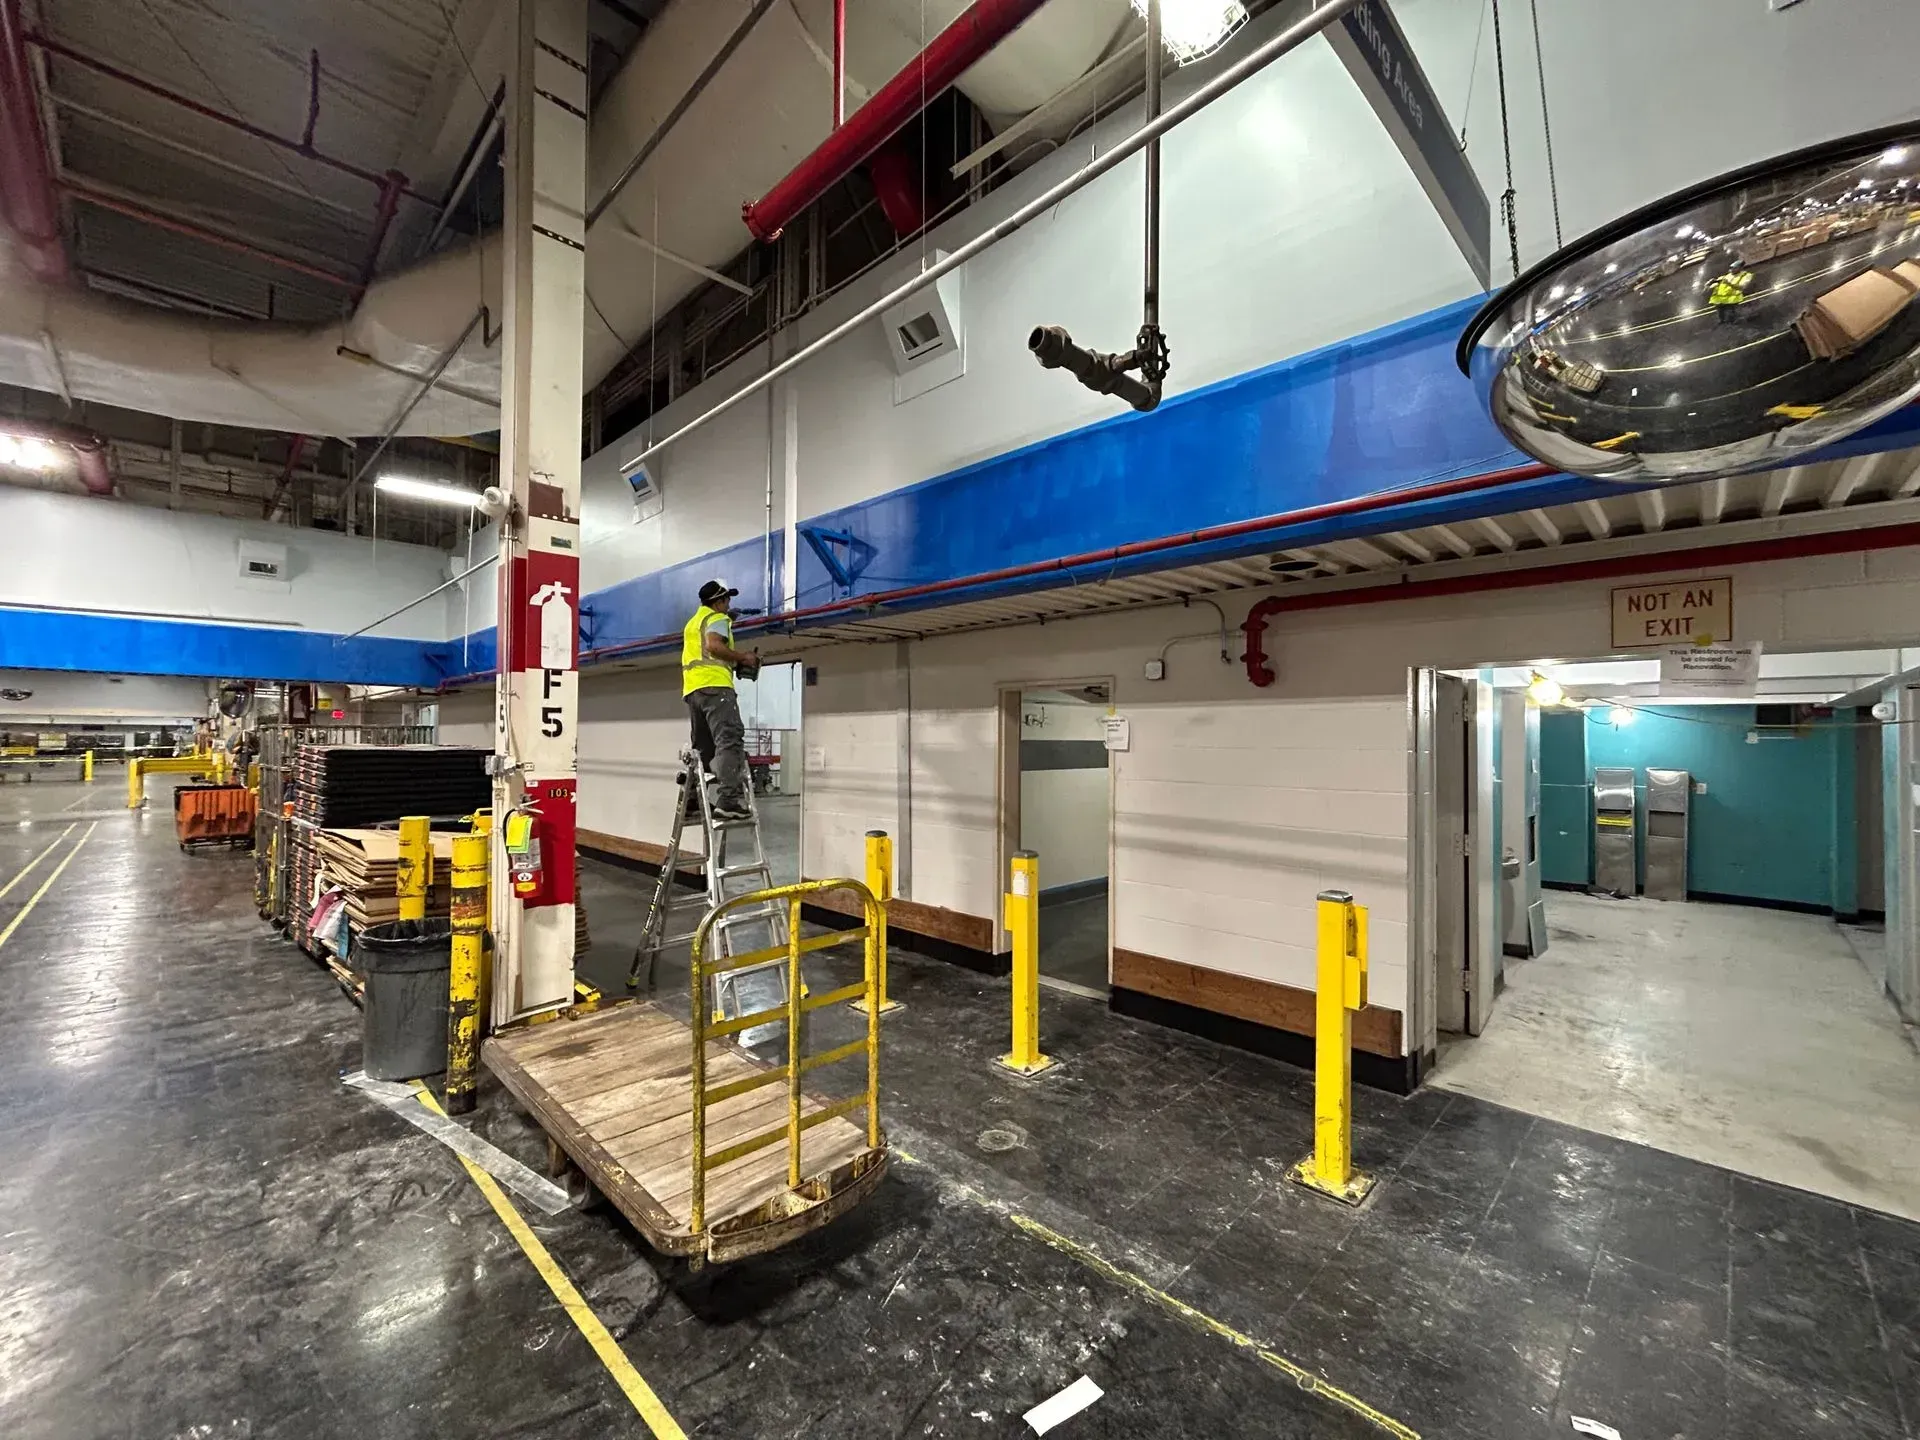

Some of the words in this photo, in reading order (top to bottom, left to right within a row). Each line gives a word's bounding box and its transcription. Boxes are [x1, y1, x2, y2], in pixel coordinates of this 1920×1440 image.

[1394, 61, 1422, 129] Area
[1628, 592, 1670, 613] NOT
[1683, 589, 1713, 609] AN
[1645, 617, 1694, 637] EXIT
[543, 669, 562, 699] F
[541, 707, 563, 738] 5
[550, 788, 568, 798] 103
